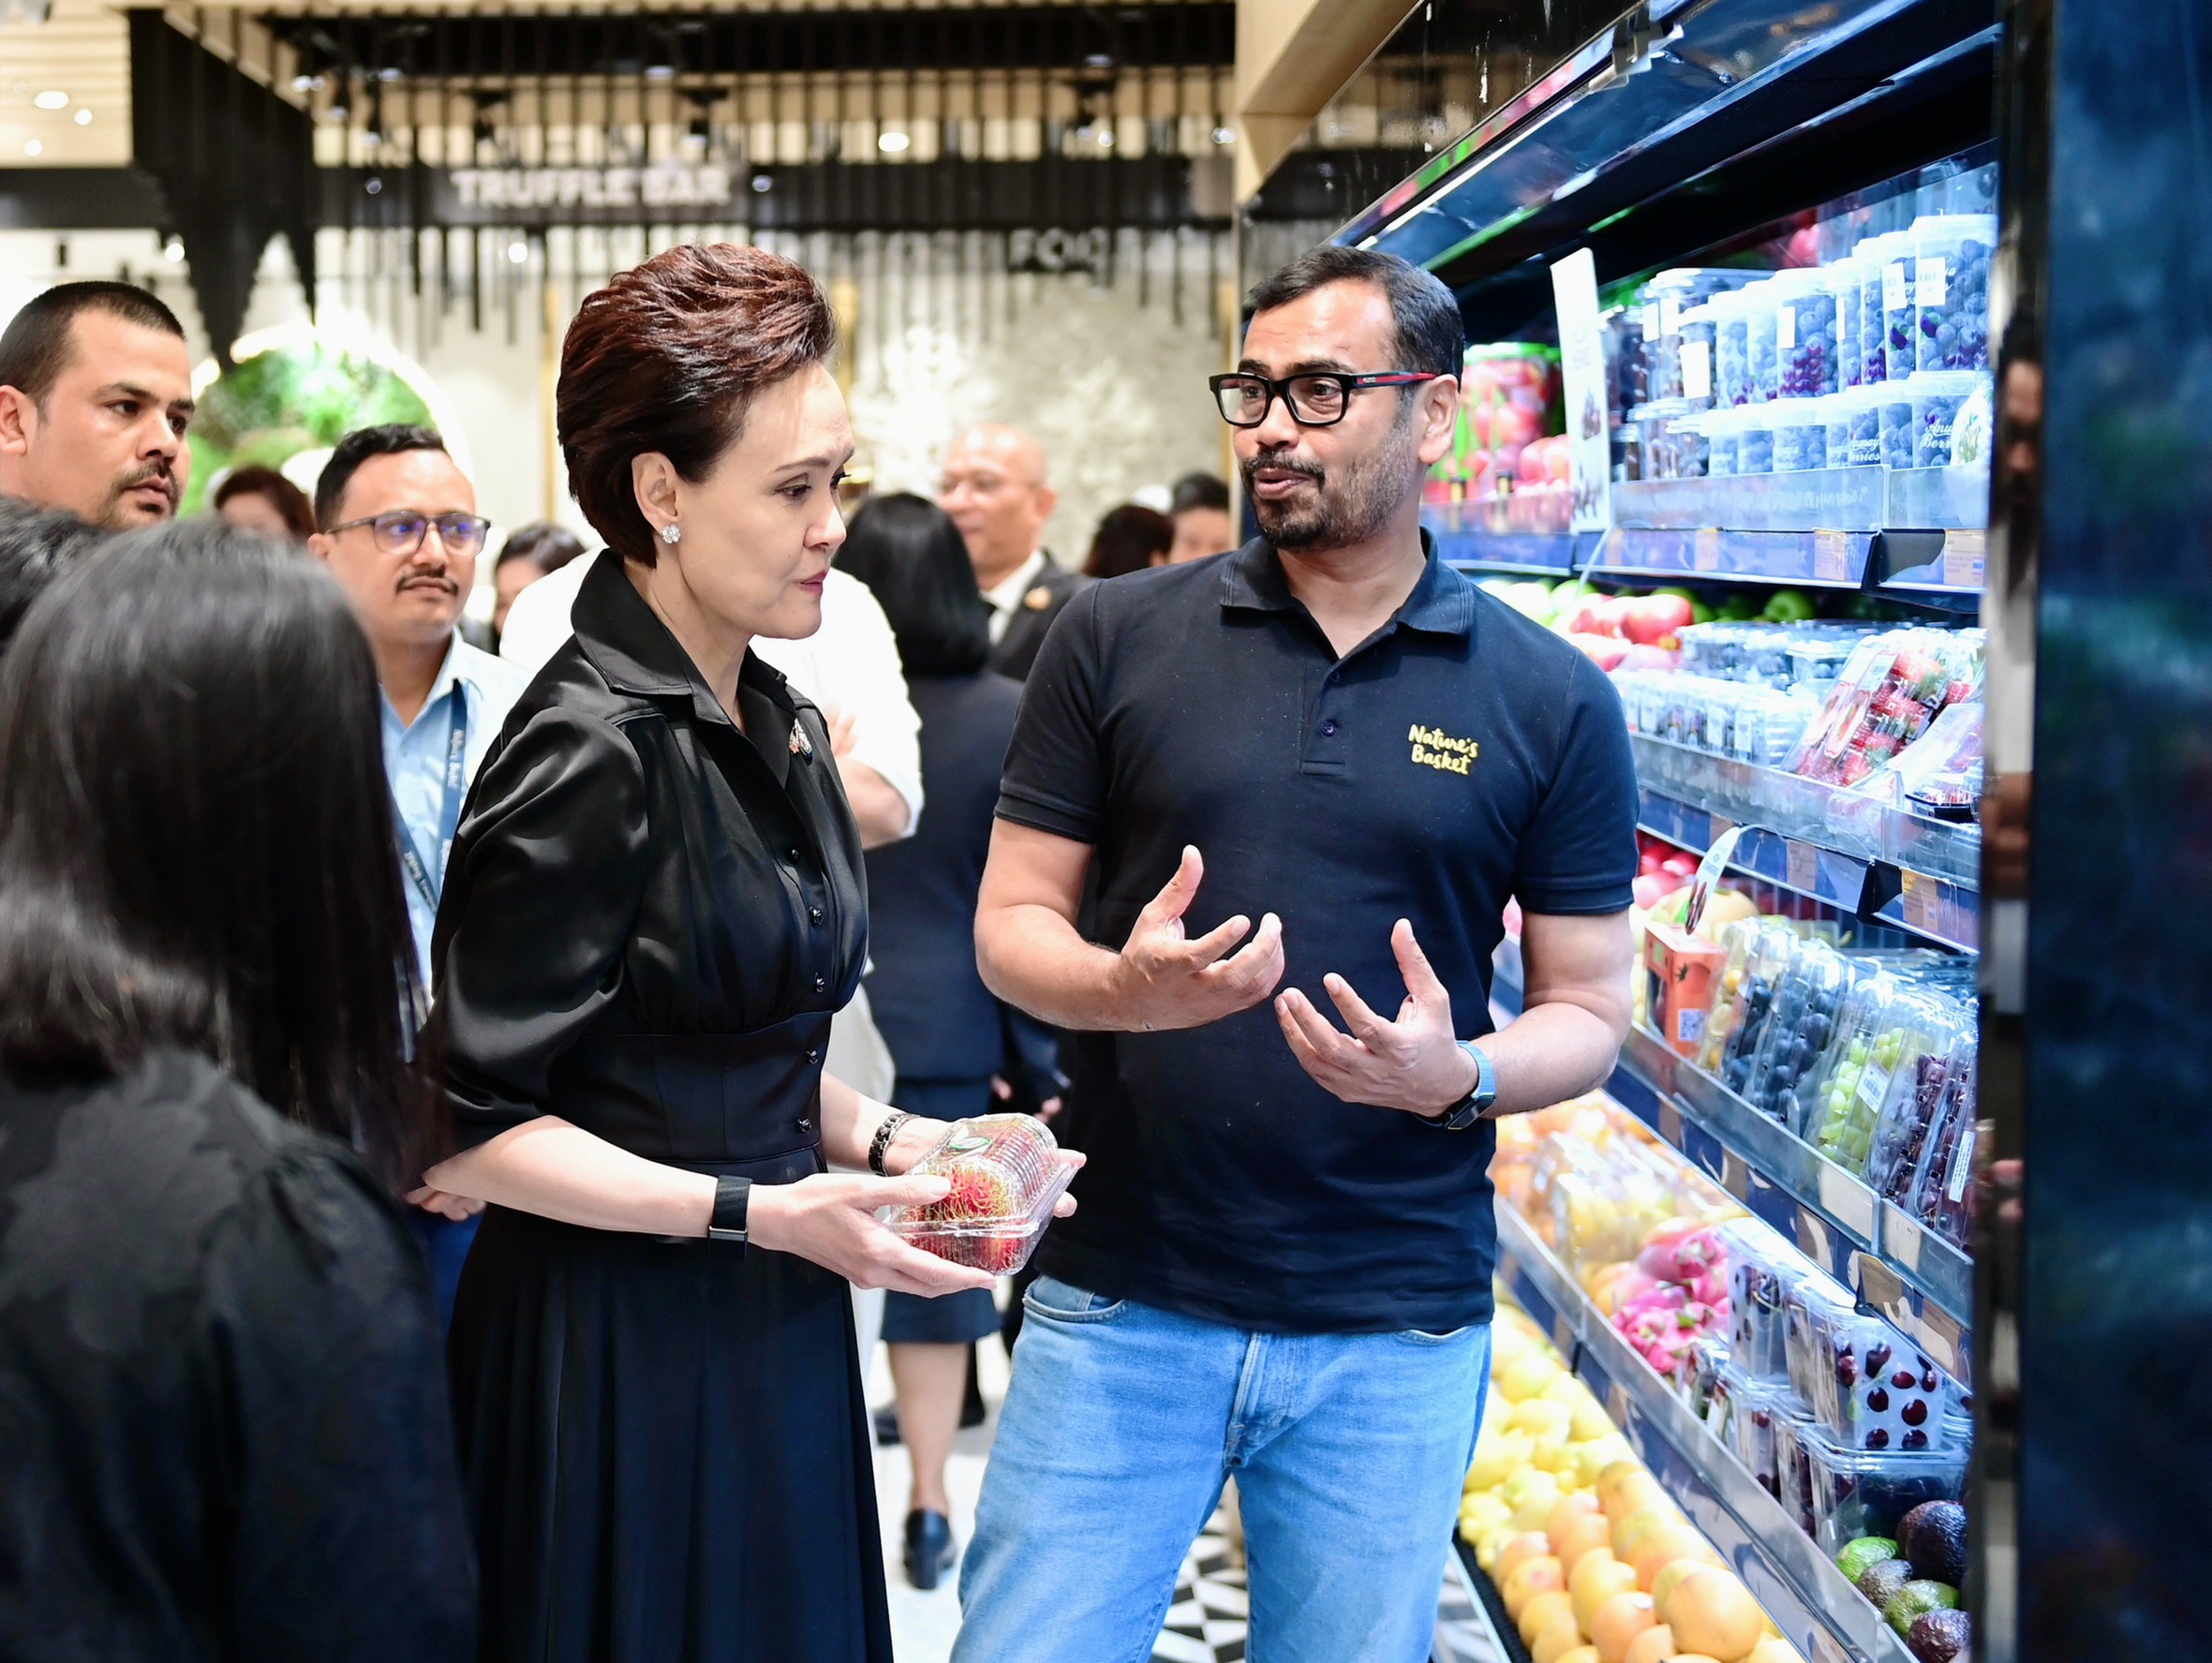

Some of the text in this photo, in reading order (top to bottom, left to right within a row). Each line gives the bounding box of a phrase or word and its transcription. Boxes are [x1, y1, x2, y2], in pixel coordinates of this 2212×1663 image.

[452, 169, 731, 207] TRUFFLE BAR
[1408, 723, 1478, 758] Nature's
[1411, 743, 1472, 776] Basket
